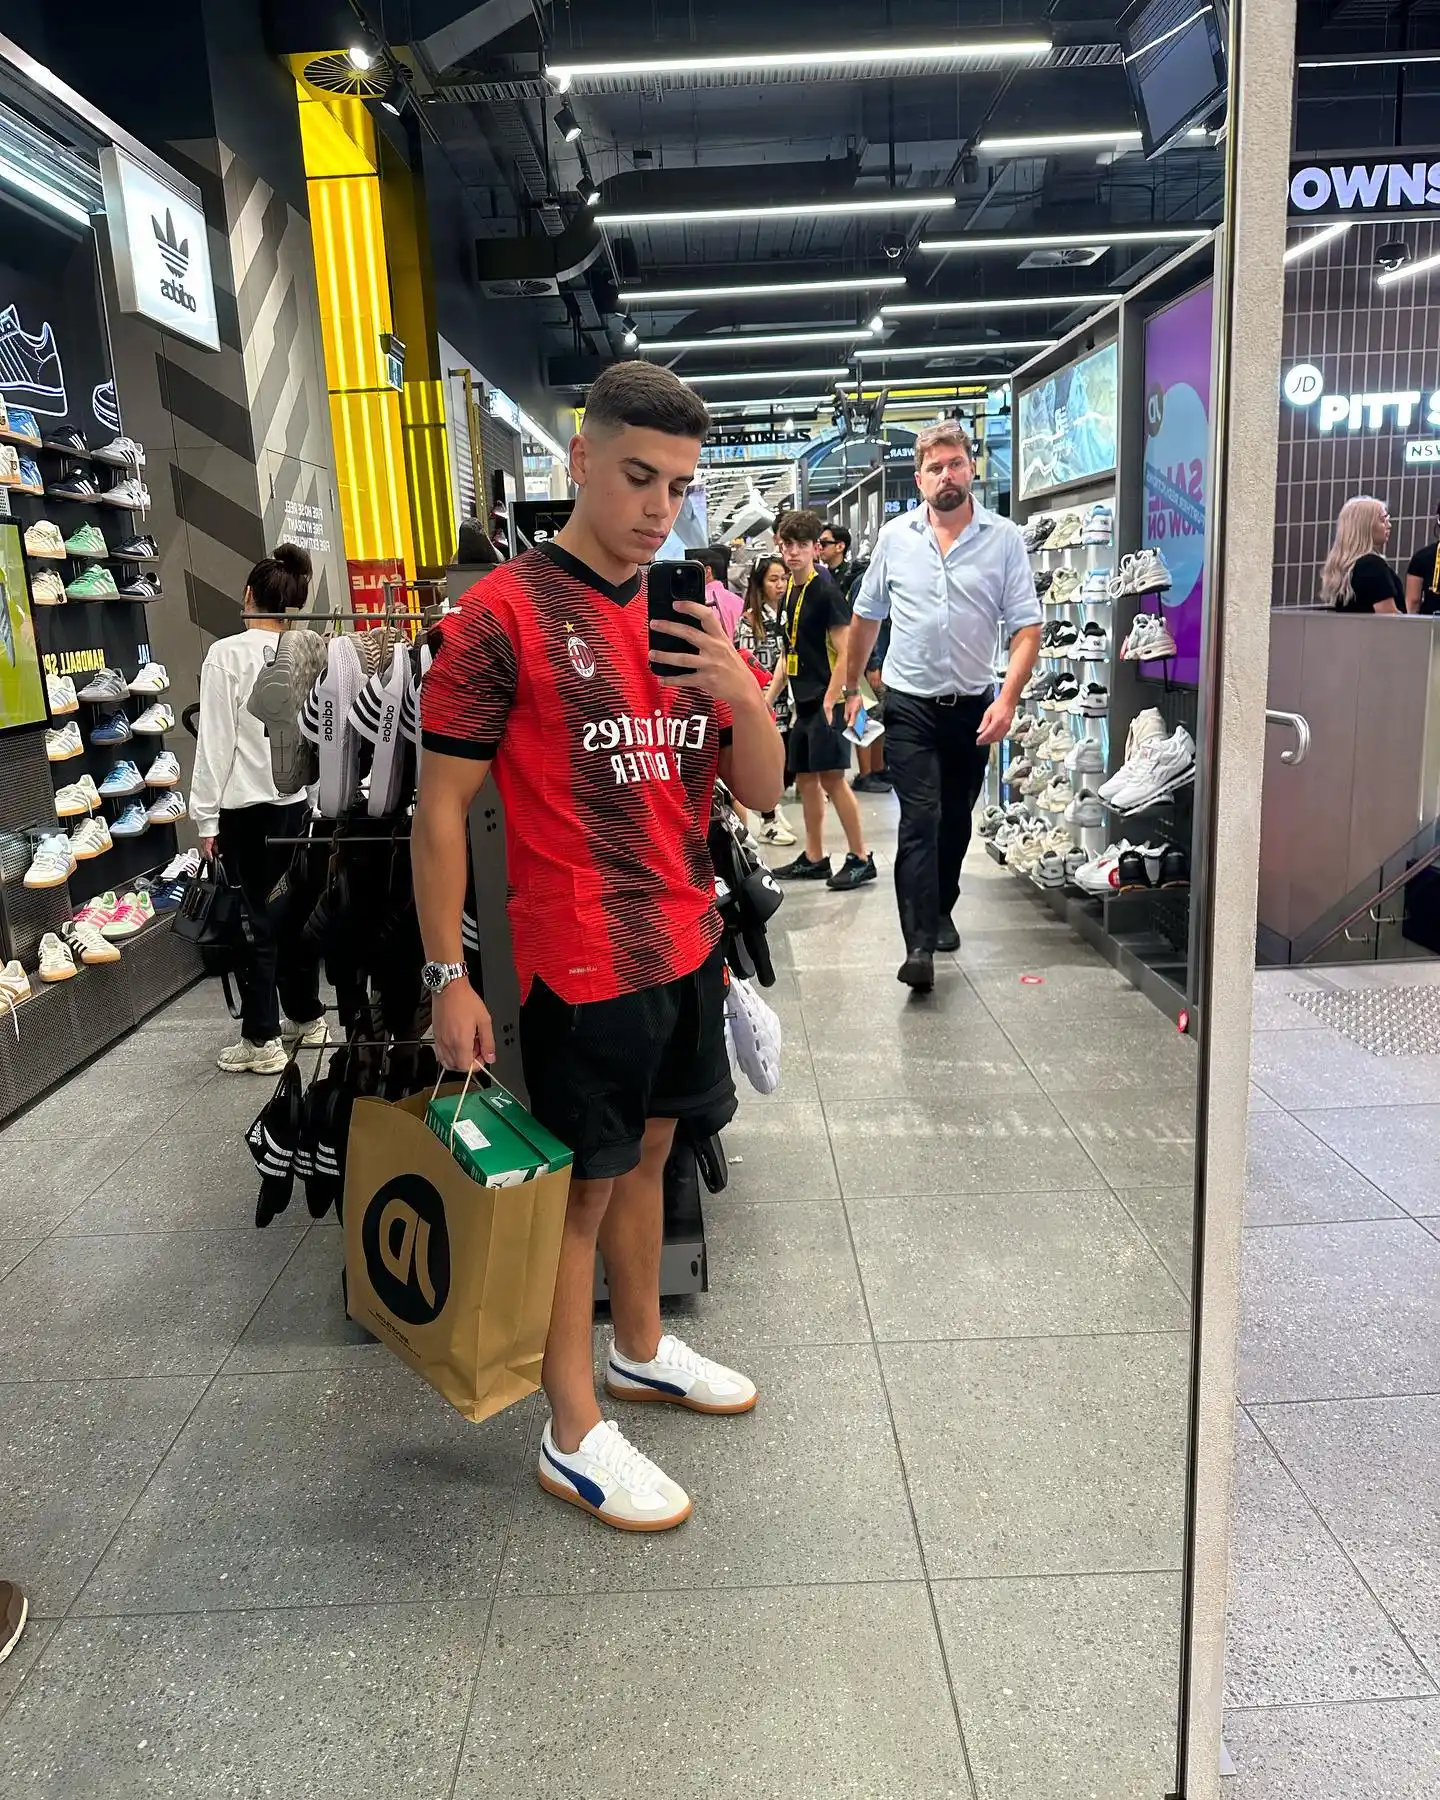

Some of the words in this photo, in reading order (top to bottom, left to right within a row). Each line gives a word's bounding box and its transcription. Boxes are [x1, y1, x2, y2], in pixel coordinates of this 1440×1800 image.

[1287, 162, 1440, 211] OWN
[1292, 376, 1316, 393] JD
[1319, 391, 1421, 431] PITT
